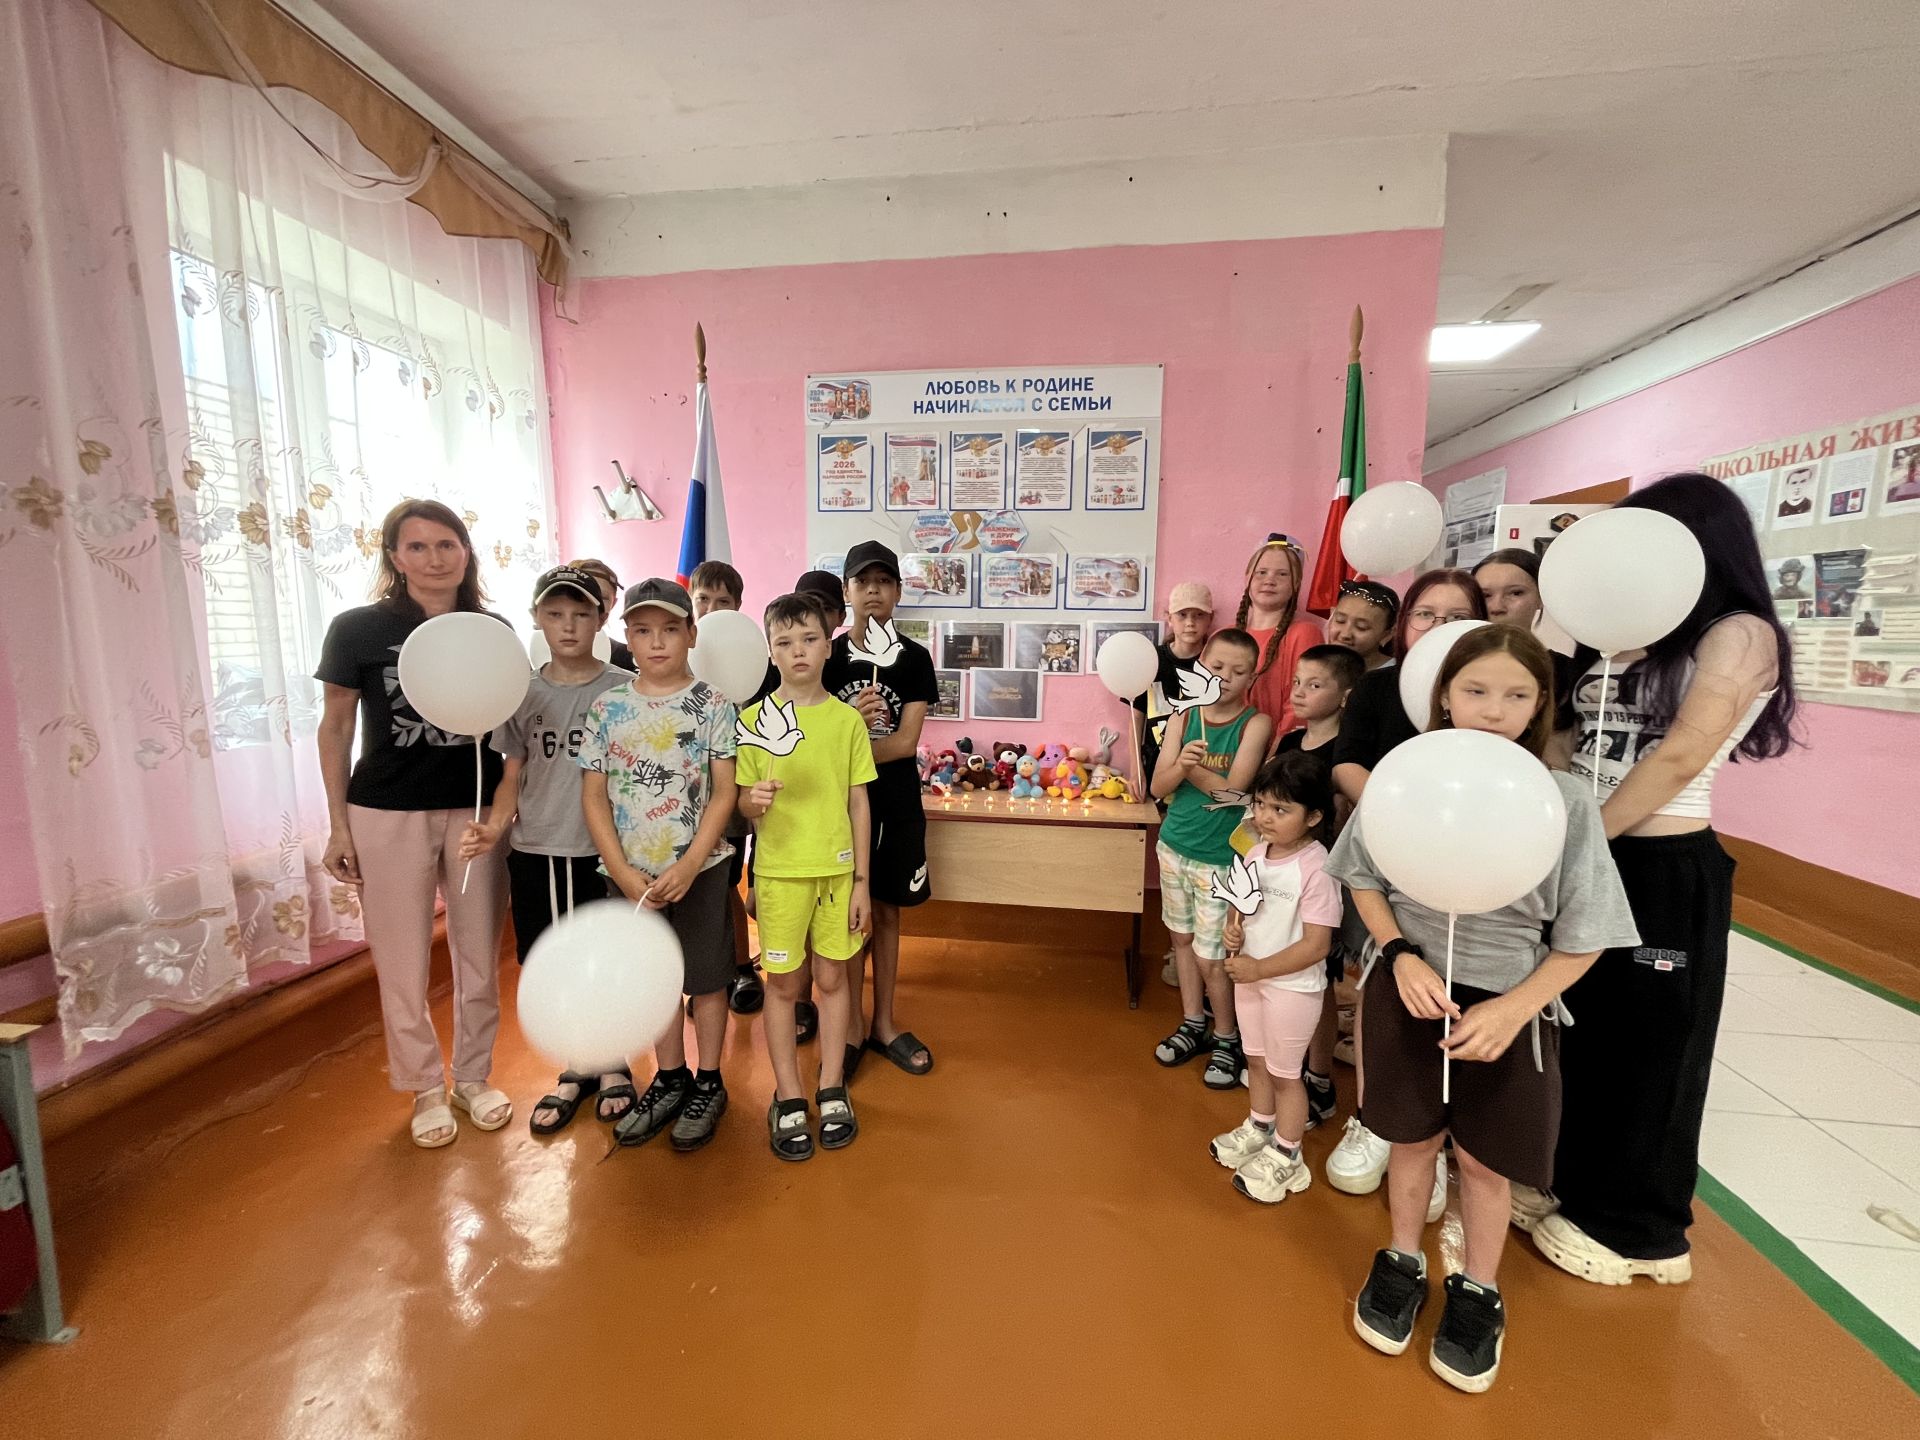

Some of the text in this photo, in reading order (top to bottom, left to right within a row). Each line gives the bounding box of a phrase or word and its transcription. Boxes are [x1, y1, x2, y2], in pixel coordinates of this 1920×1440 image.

[925, 377, 1095, 395] ЛЮБОВЬ К РОДИНЕ
[1032, 398, 1043, 412] С
[1048, 396, 1111, 412] СЕМЬИ
[1702, 435, 1836, 480] ШКОЛЬНАЯ
[837, 679, 870, 701] REET
